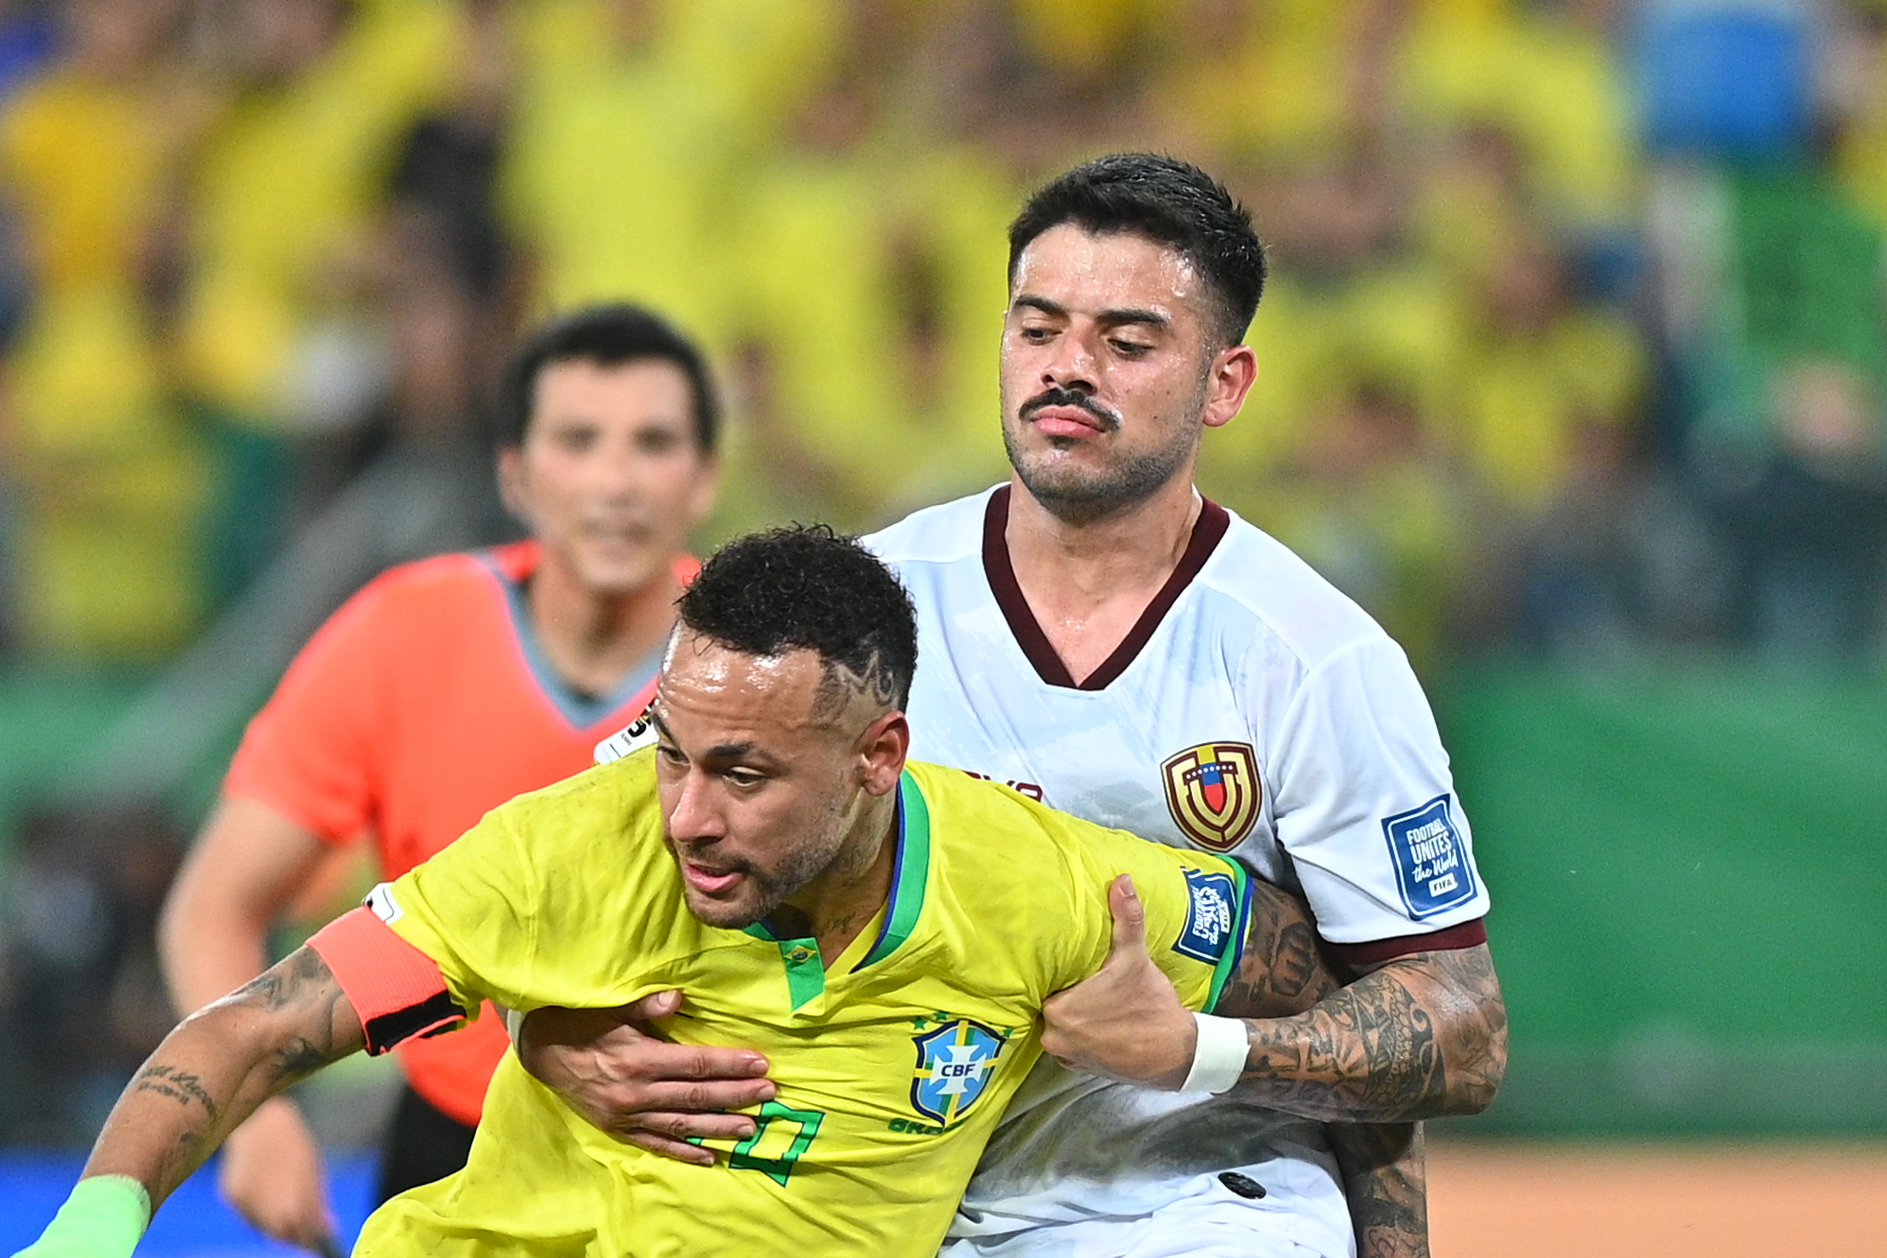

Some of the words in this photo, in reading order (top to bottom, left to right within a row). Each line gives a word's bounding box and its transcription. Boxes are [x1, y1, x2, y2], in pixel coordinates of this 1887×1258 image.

[1410, 831, 1452, 865] UNITES
[1411, 864, 1433, 883] the
[1432, 880, 1453, 892] FIFA
[940, 1062, 977, 1078] CBF
